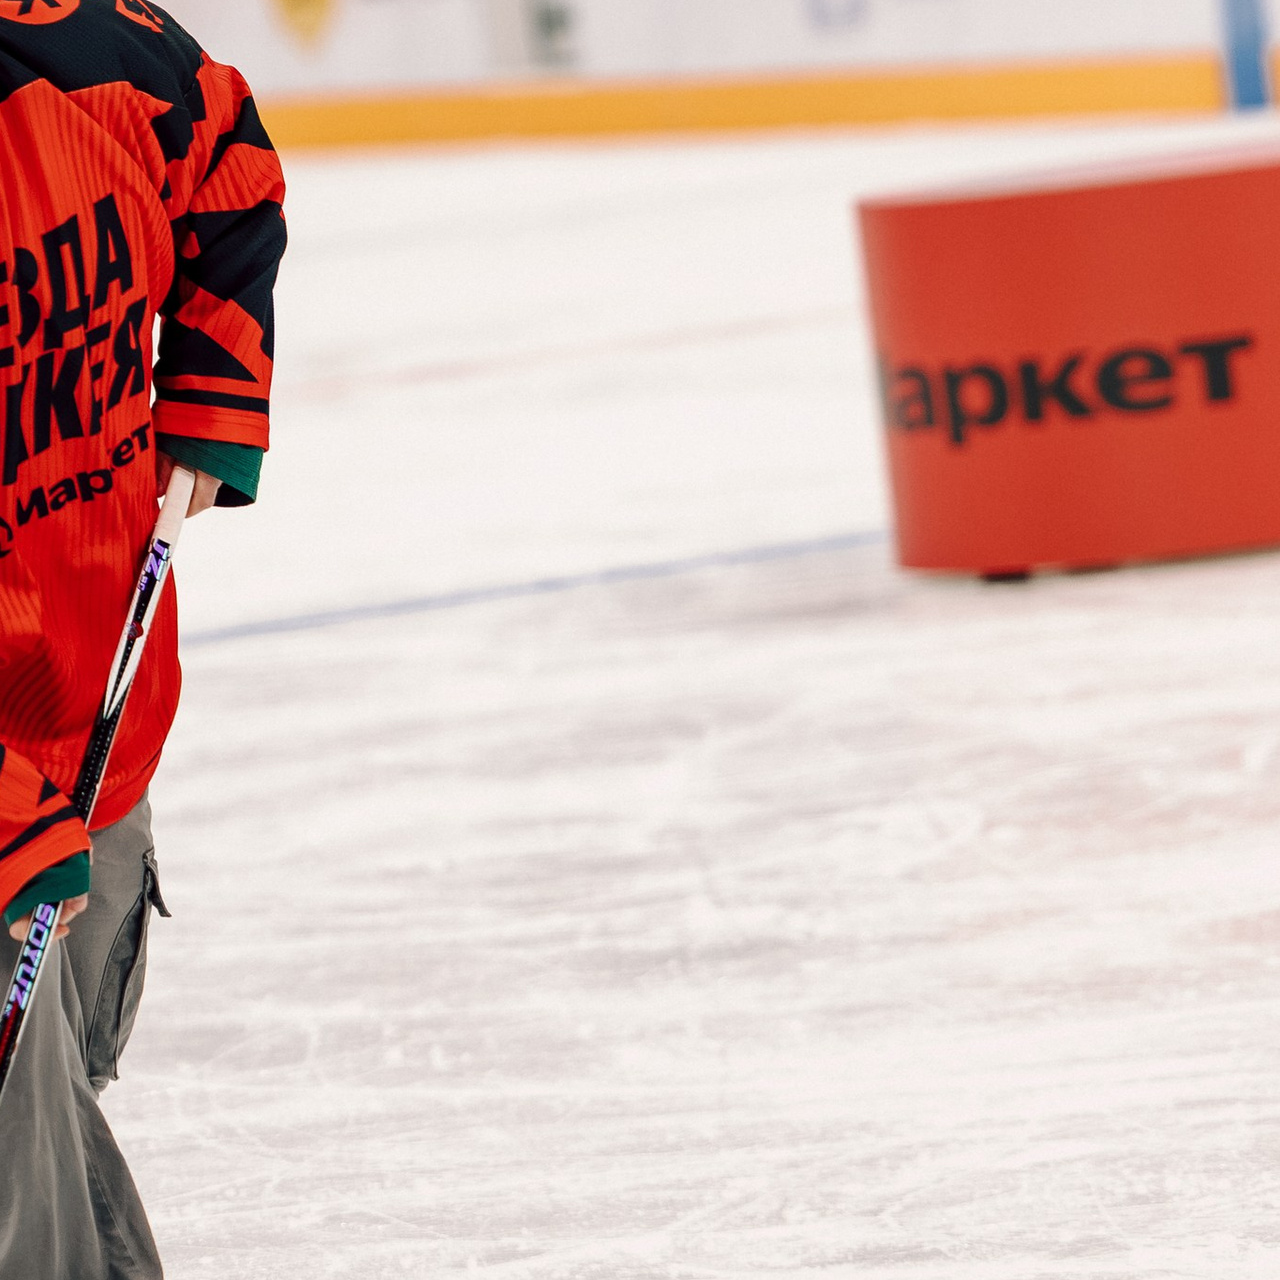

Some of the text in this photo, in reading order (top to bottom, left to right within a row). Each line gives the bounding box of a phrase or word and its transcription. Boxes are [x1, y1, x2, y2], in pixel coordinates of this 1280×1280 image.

[879, 327, 1252, 447] аркет
[15, 421, 151, 528] марет
[8, 902, 56, 1011] SOYUZ
